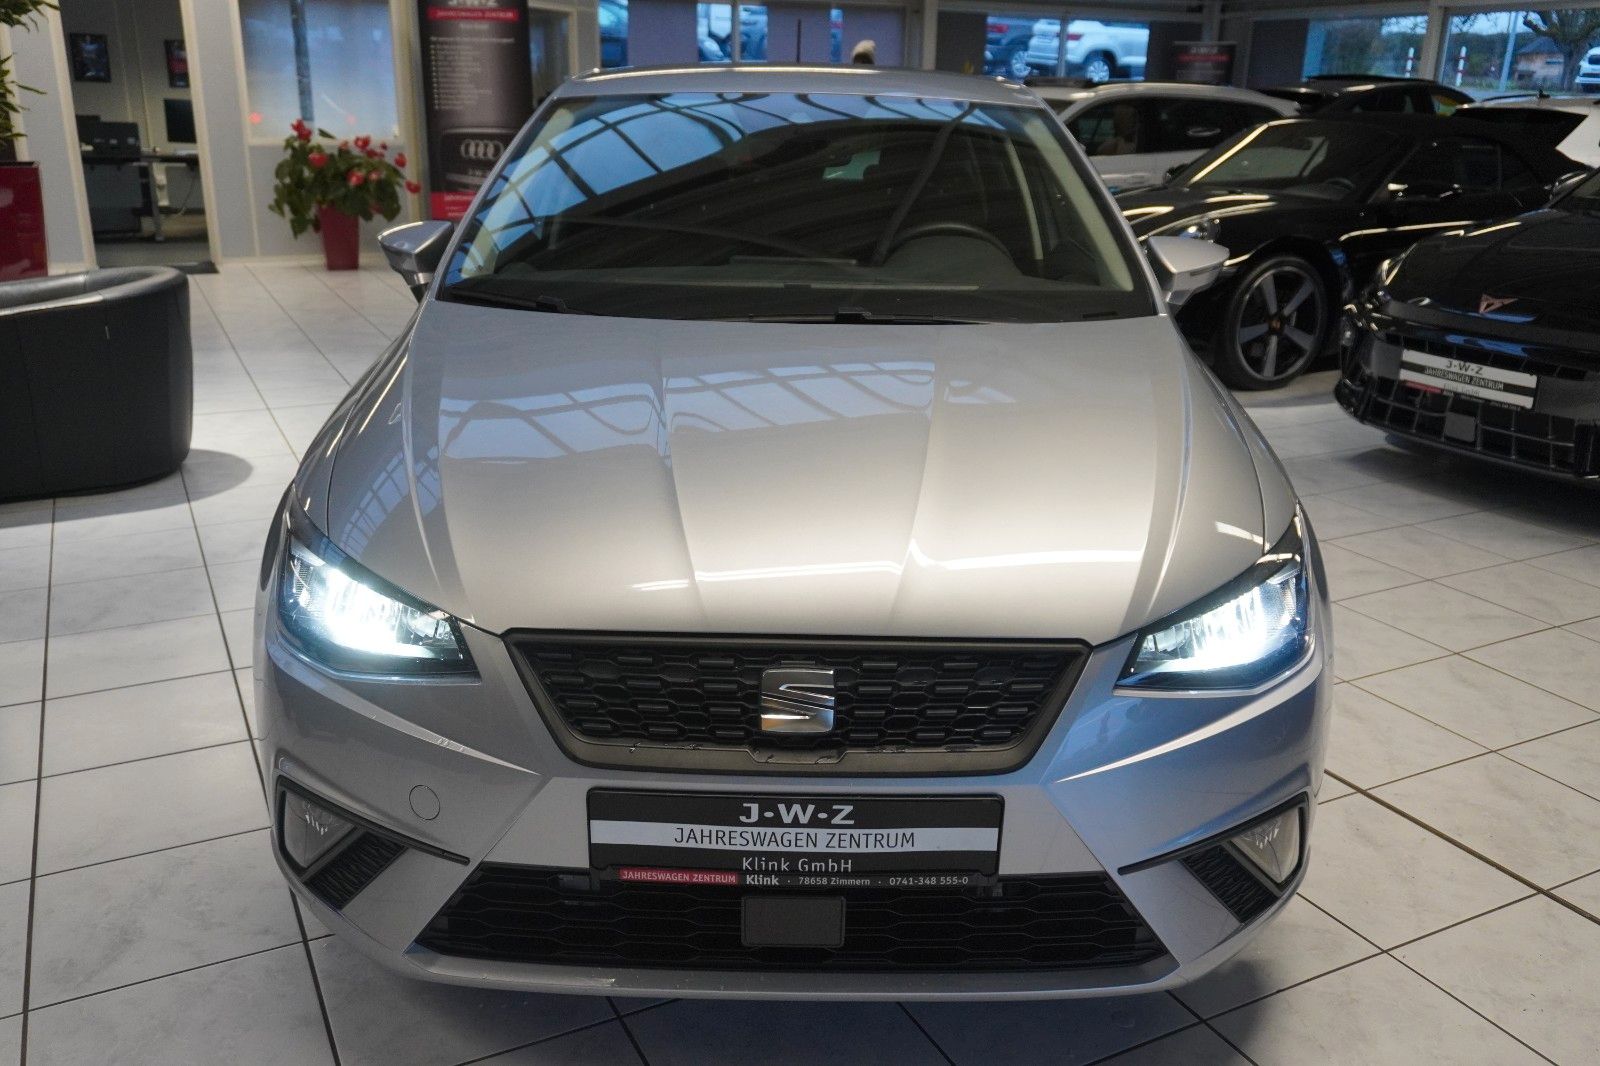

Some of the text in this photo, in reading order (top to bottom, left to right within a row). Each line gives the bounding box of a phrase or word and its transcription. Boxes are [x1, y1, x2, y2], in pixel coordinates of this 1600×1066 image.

[1471, 375, 1504, 390] ZENTRUM
[674, 827, 915, 849] JAHRESWAGEN ZENTRUM
[743, 857, 852, 872] Klink GmbH
[622, 870, 736, 883] JAHRESWAGEN ZENTRUM
[746, 874, 969, 886] Klink 78658 Zimmern 0741-348 555-0
